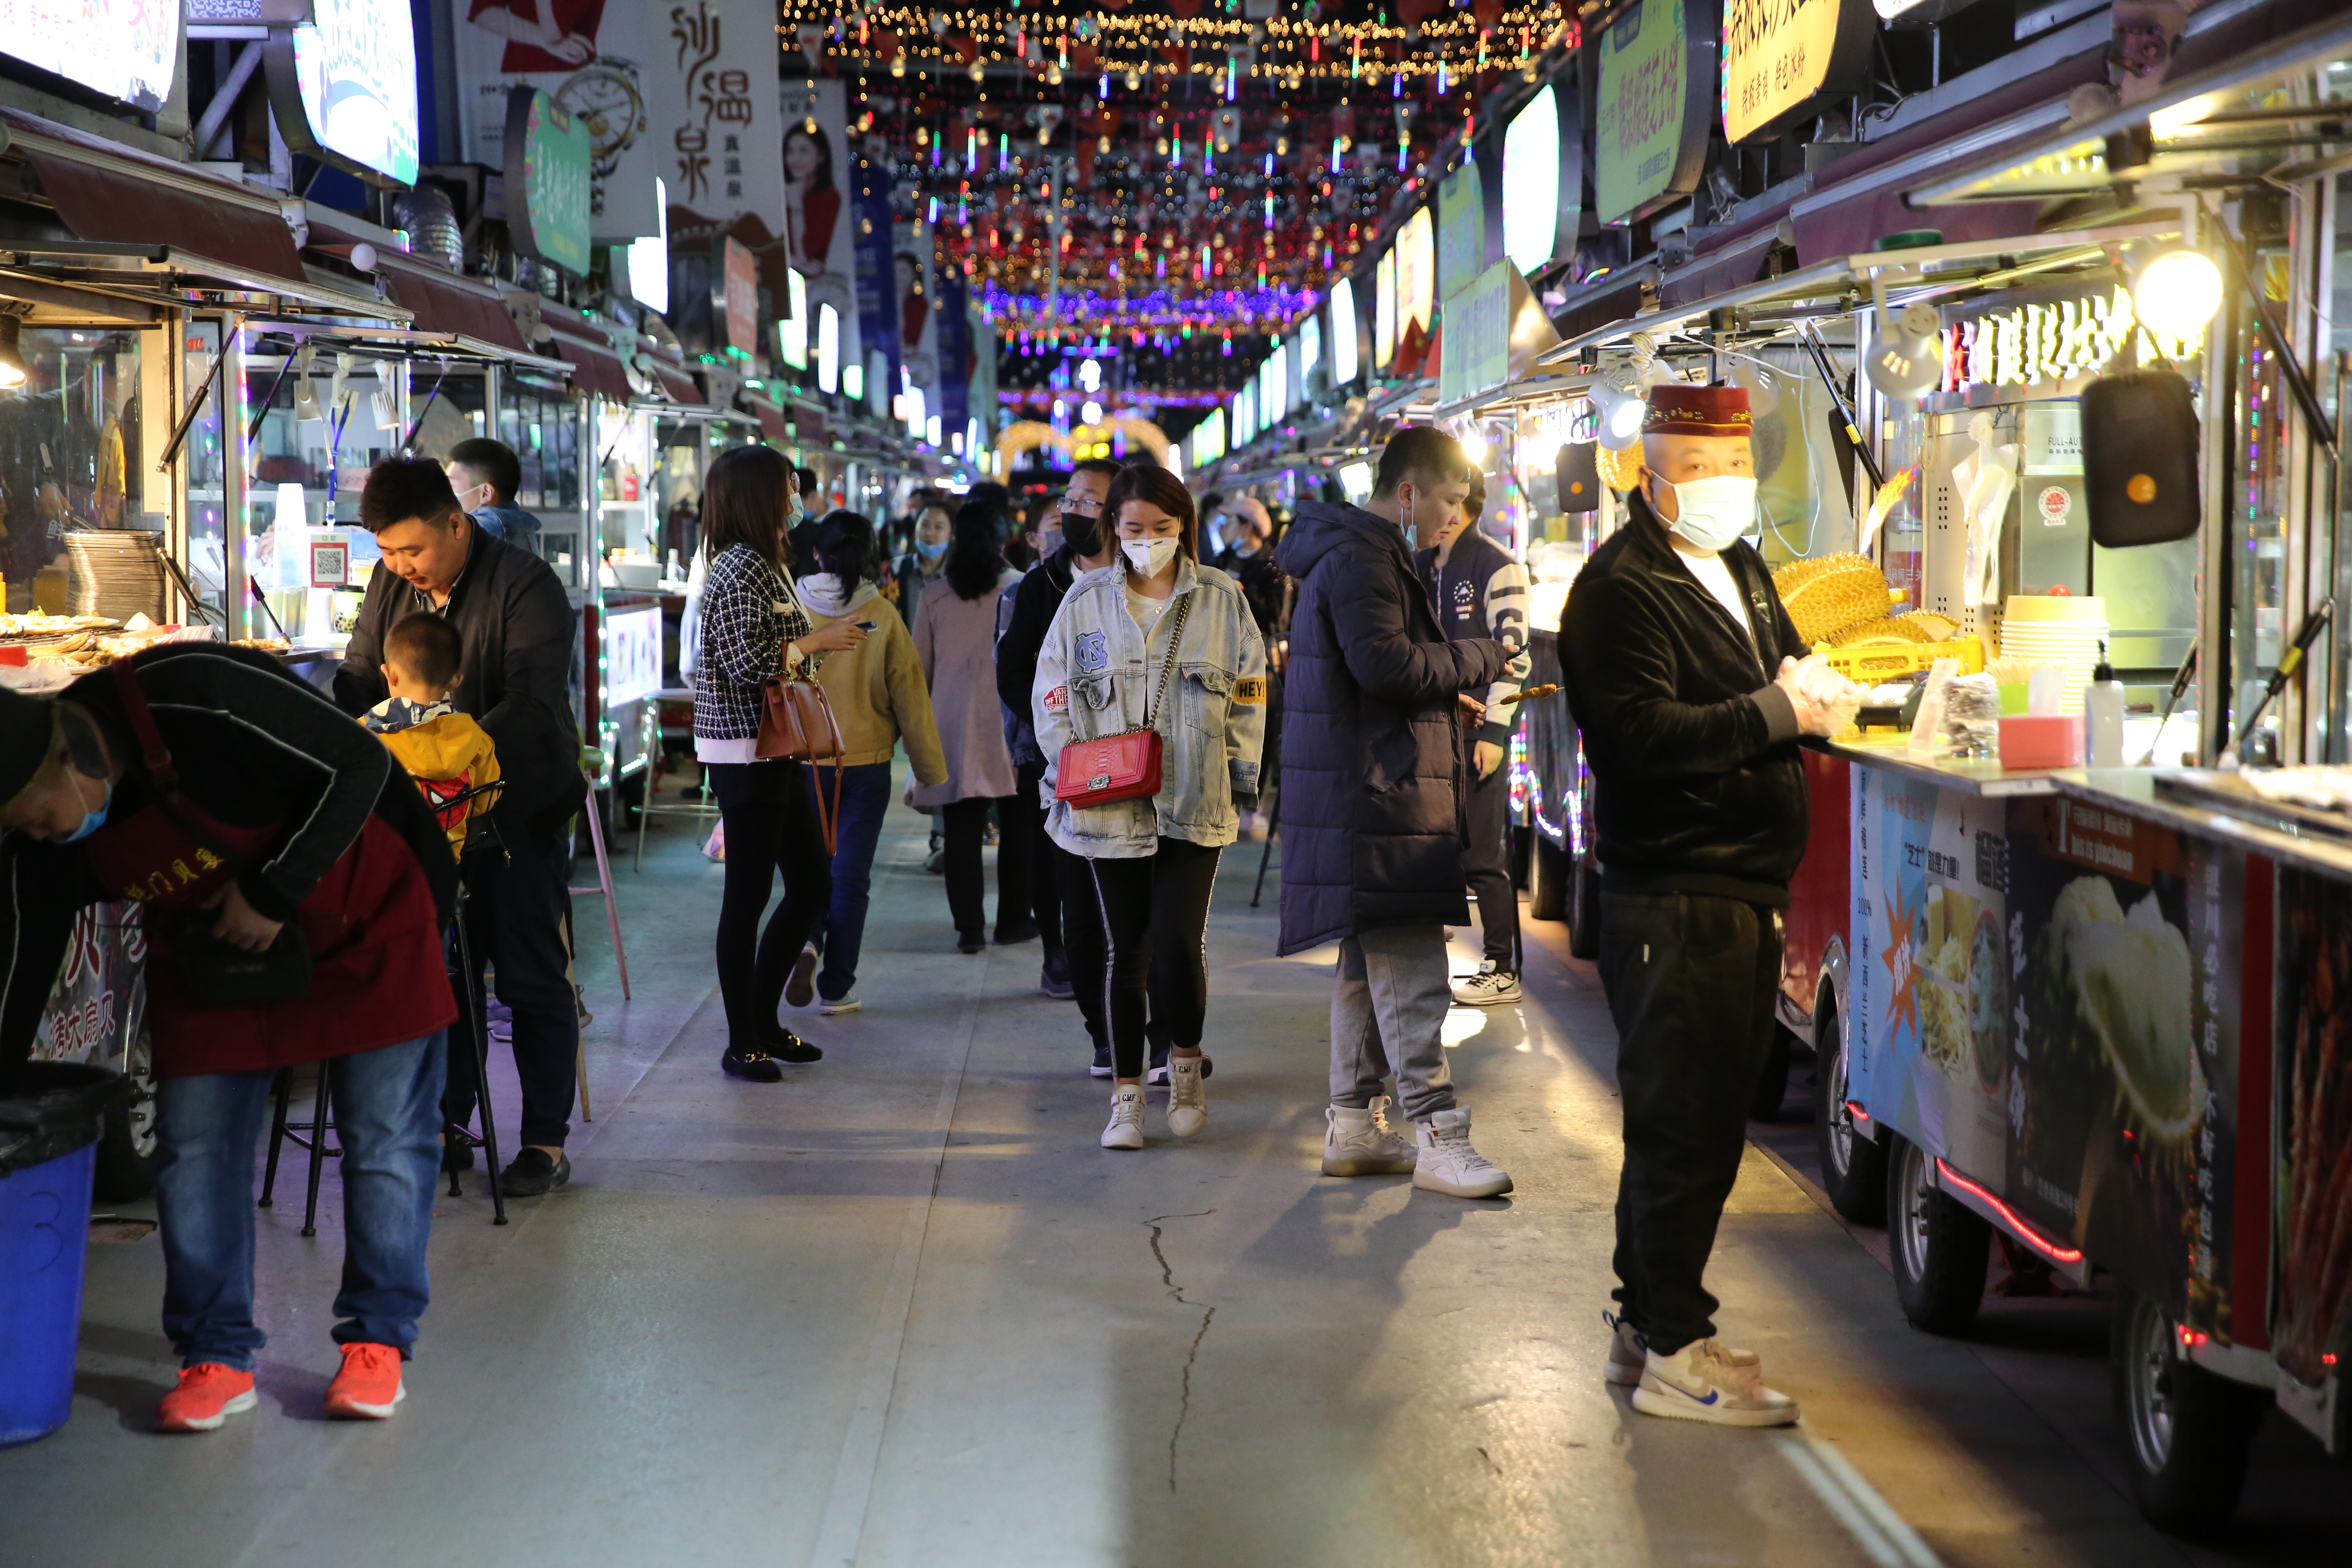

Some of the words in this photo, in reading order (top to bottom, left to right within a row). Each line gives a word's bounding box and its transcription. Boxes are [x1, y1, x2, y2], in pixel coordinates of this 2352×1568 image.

[724, 133, 743, 199] 真温泉
[1239, 681, 1265, 697] HEY!
[1857, 897, 1872, 917] 100%
